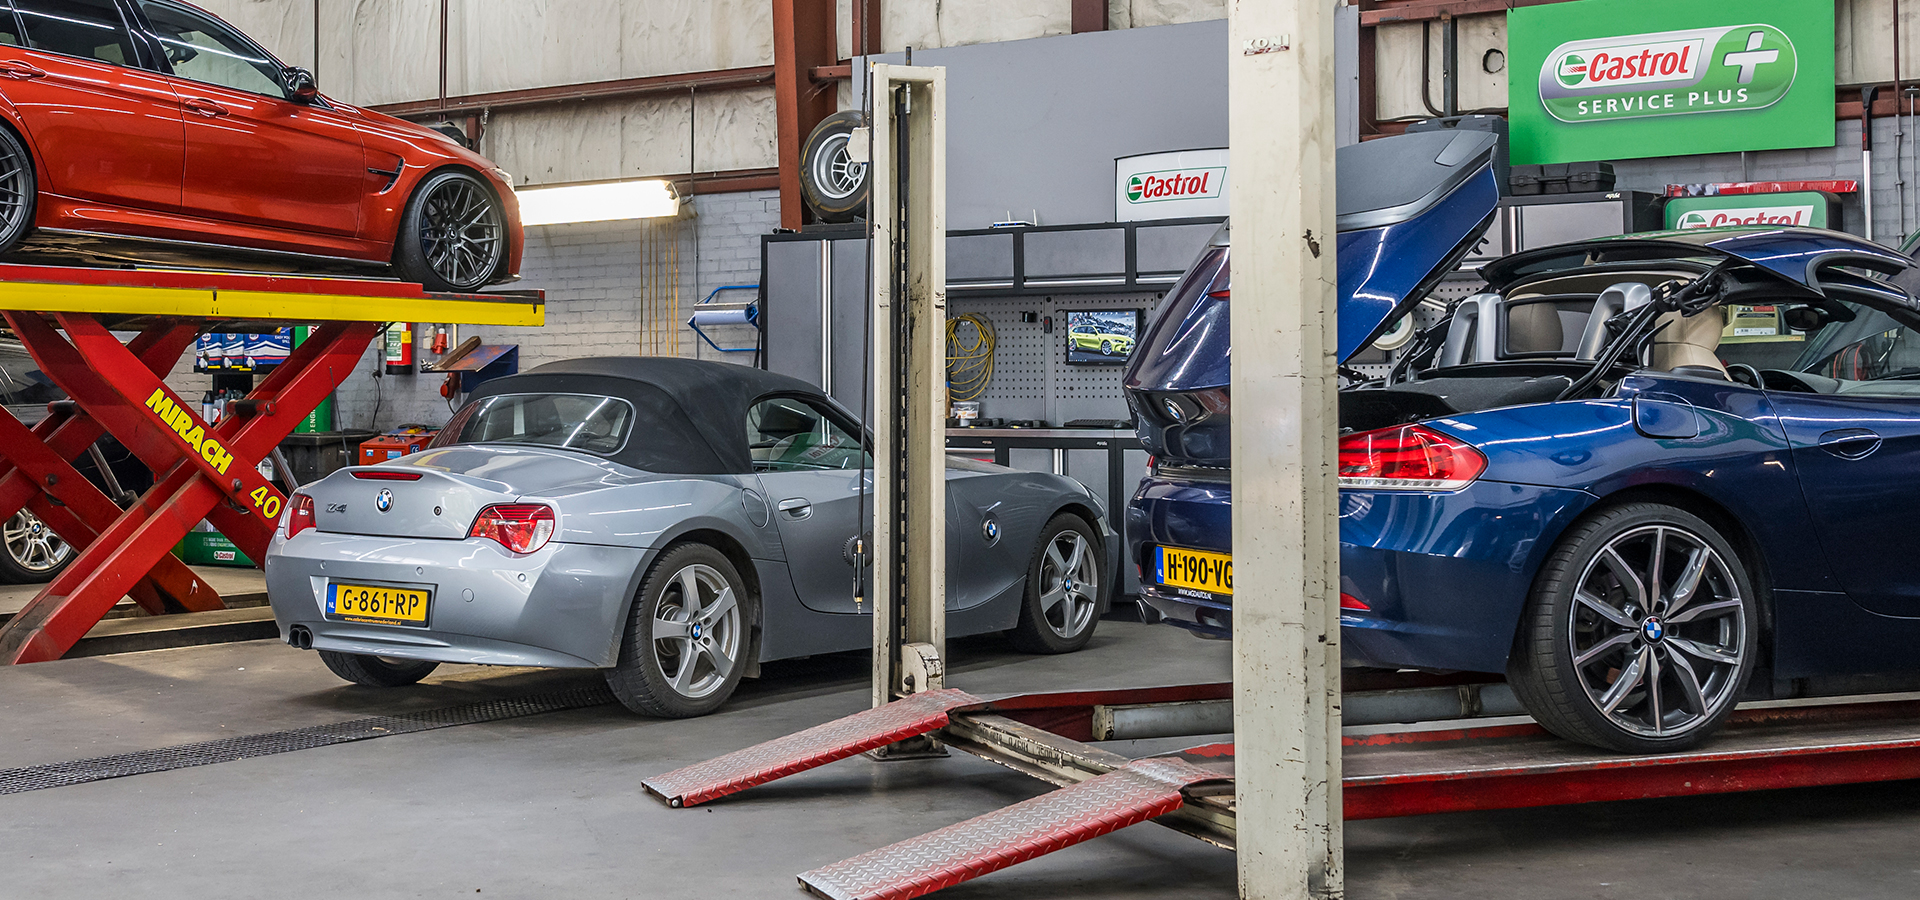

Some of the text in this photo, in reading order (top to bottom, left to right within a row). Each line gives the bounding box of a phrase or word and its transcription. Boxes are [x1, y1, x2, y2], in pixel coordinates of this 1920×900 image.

[1243, 34, 1289, 50] KONI
[1589, 45, 1690, 82] Castrol
[1578, 87, 1749, 115] SERVICE PLUS
[1143, 172, 1209, 198] Castrol
[144, 387, 281, 519] MIRACH 40
[326, 502, 347, 514] Z4
[328, 601, 335, 609] NL
[343, 588, 419, 616] G-861-RP
